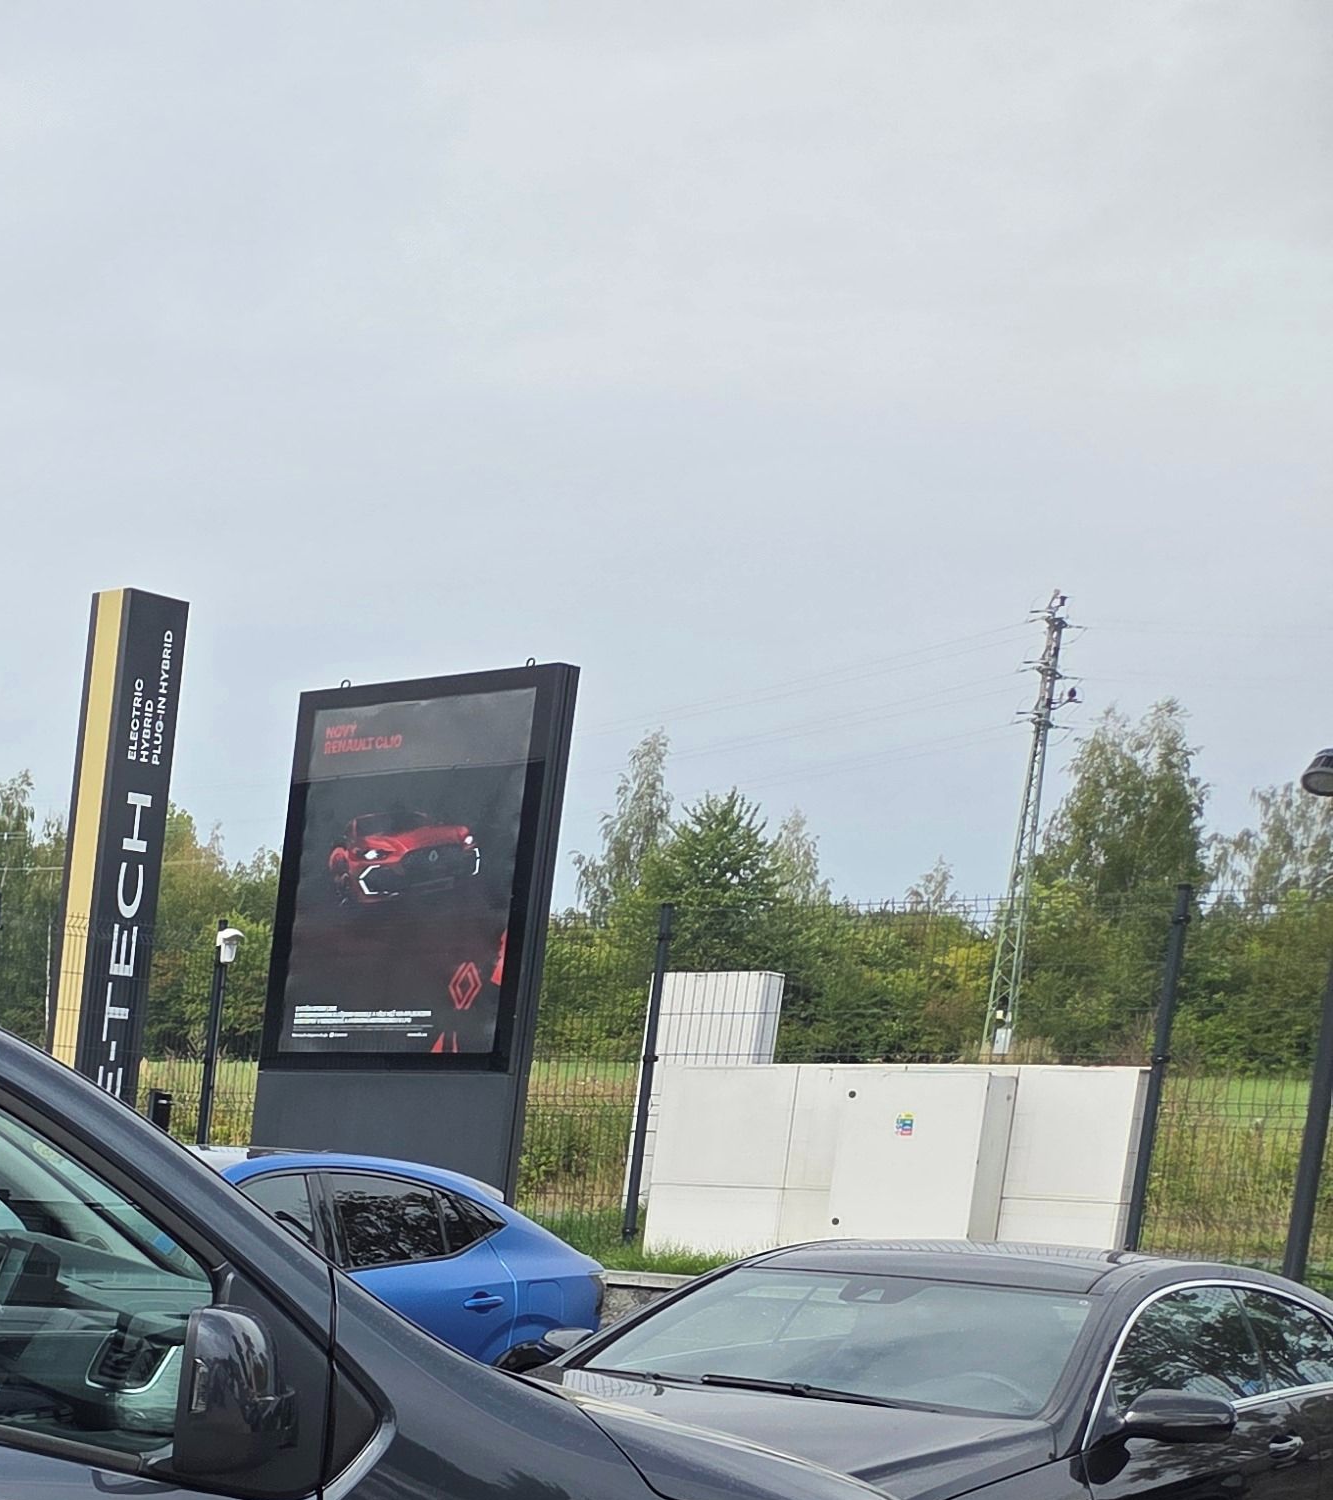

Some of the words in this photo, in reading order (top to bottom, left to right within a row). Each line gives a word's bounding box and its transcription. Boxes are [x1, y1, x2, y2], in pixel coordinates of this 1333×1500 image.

[158, 630, 173, 694] HYBRID
[127, 678, 144, 761] ELECTRIC
[139, 699, 154, 763] HYBRID
[151, 696, 167, 766] PLUG-IN
[324, 737, 375, 755] RENAULT
[375, 734, 403, 750] CLIO
